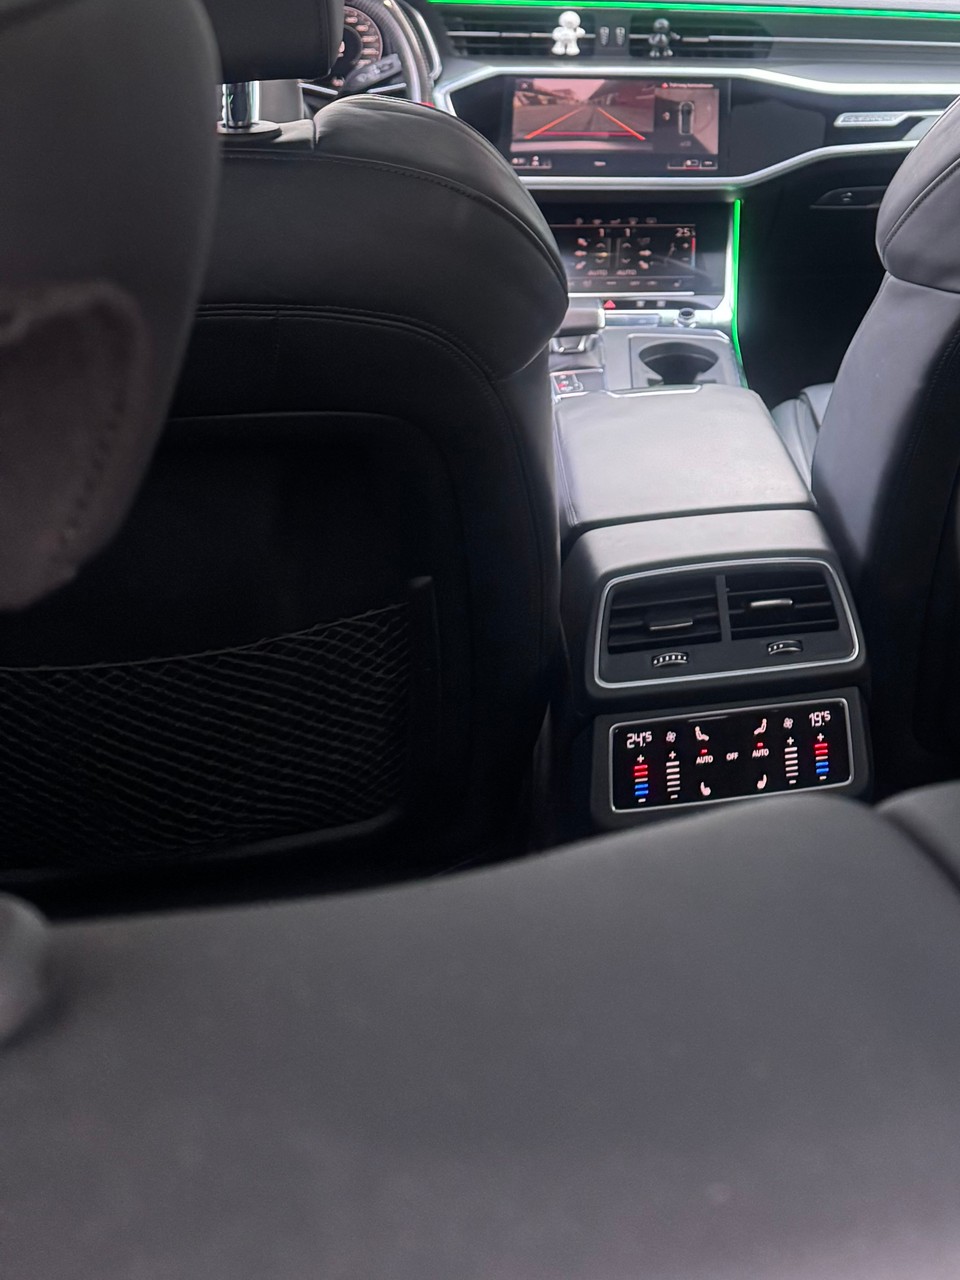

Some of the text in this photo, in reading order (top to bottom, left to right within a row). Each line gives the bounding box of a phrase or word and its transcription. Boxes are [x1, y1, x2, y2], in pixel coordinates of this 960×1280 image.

[726, 752, 739, 761] OFF
[752, 748, 770, 758] AUTO
[695, 755, 714, 764] AUTO
